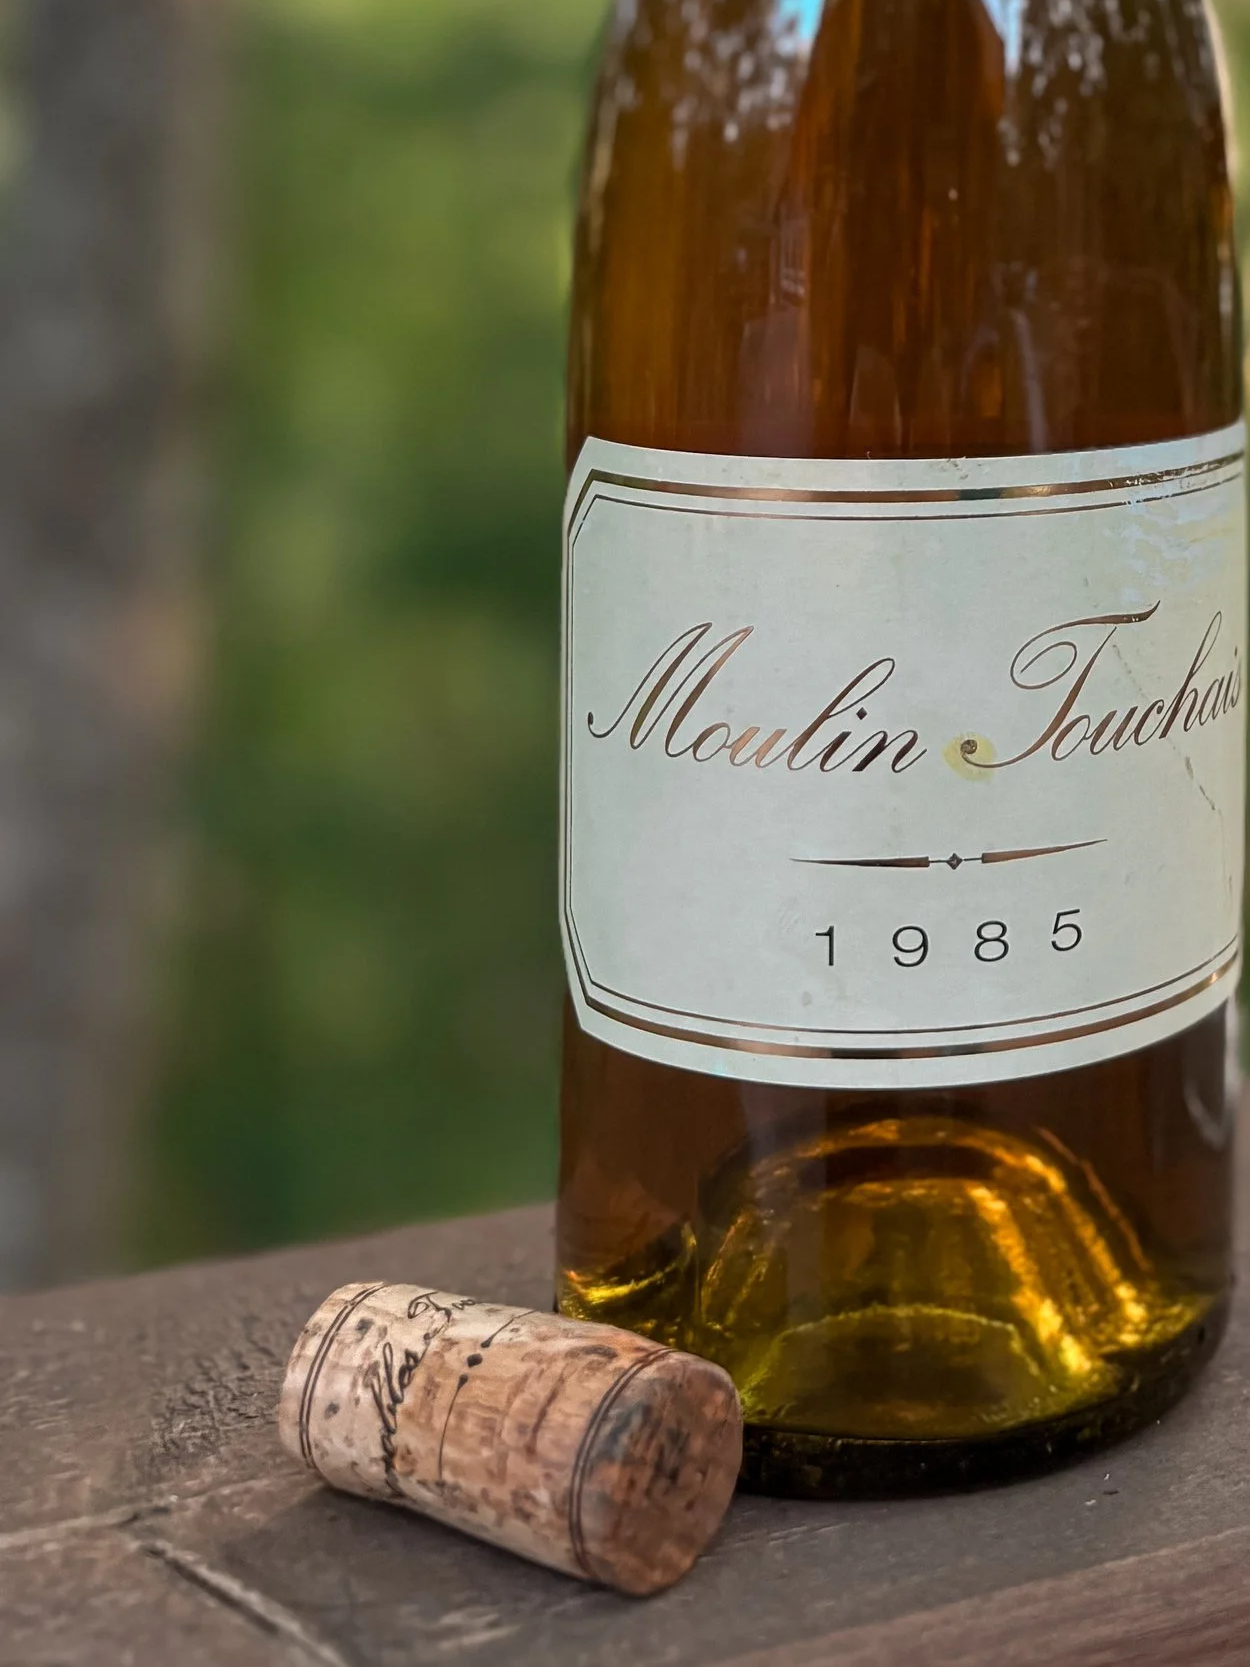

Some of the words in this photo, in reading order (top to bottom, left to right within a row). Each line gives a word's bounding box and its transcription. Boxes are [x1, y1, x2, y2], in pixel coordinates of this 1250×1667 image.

[588, 621, 927, 774] Moulin
[960, 599, 1242, 768] Touchais
[813, 908, 1083, 968] 1985
